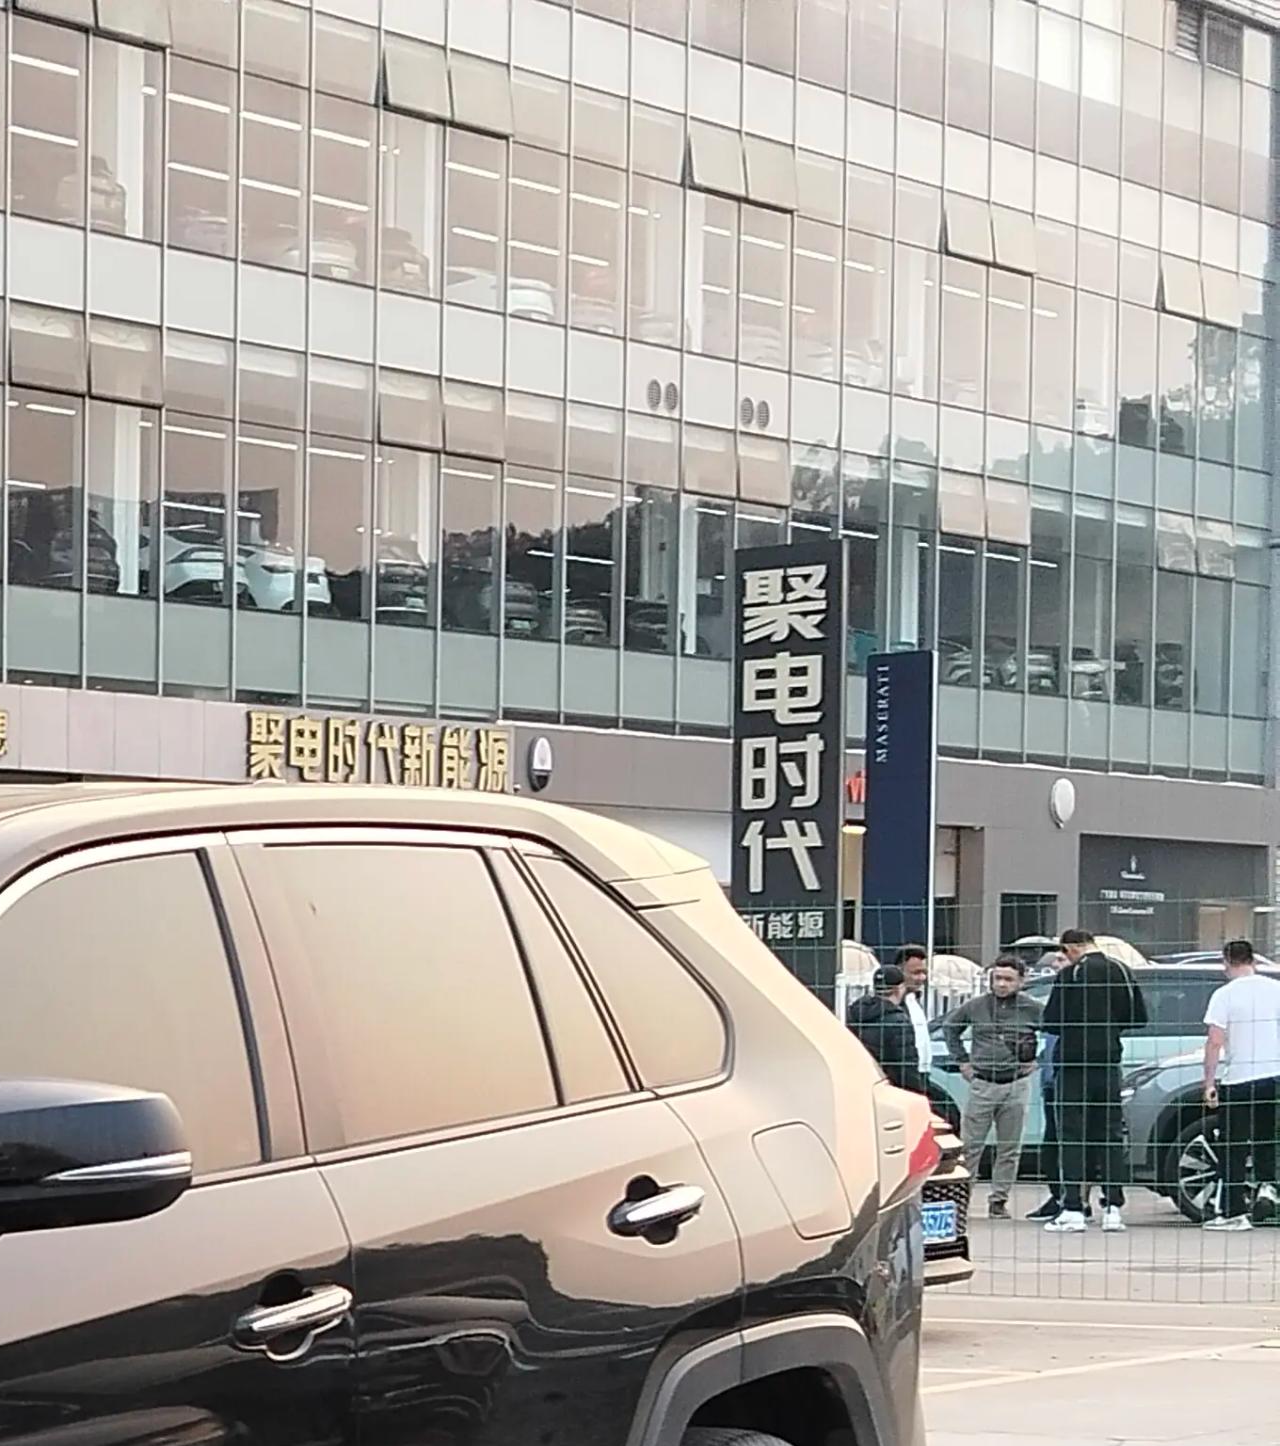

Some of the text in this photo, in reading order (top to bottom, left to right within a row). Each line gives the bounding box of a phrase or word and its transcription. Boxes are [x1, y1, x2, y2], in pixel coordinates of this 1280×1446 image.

[246, 710, 512, 793] 聚电时代新能源
[741, 562, 828, 894] 聚电时代
[875, 665, 891, 763] MASERATI
